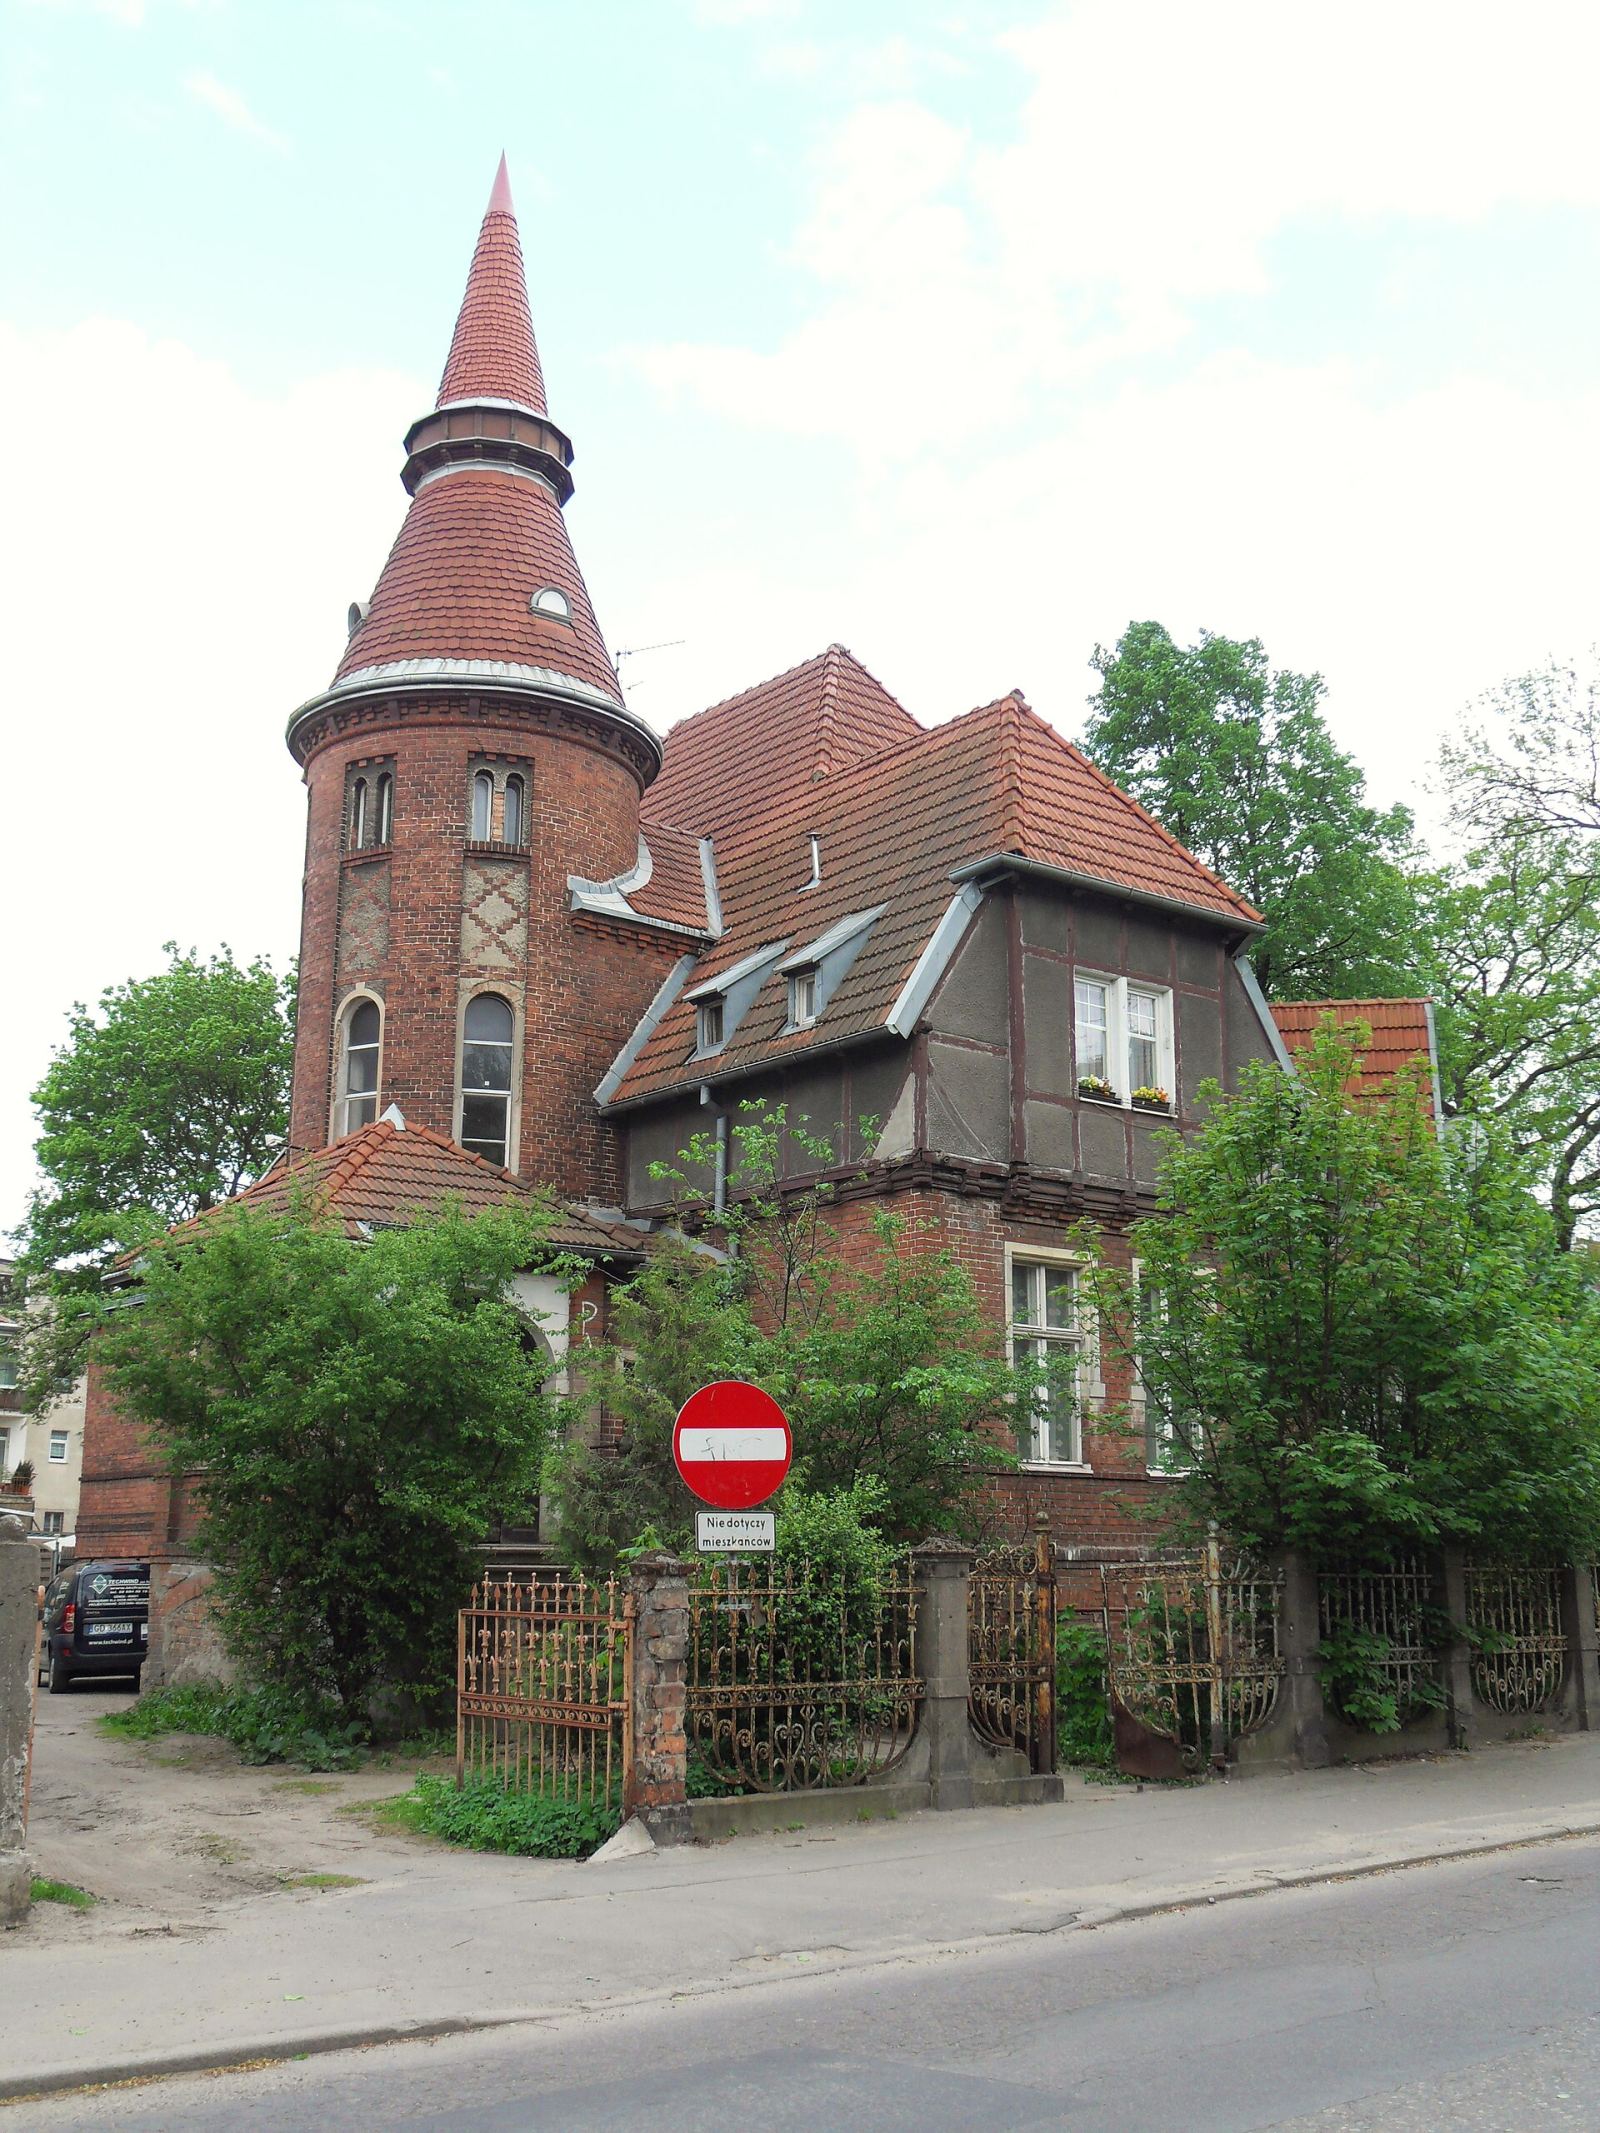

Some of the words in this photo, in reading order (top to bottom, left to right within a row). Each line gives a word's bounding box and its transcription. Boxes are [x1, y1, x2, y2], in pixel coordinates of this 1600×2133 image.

[707, 1517, 725, 1528] Nie
[726, 1517, 766, 1531] dotyczy
[702, 1535, 771, 1547] mieszkańców
[94, 1624, 105, 1632] GD
